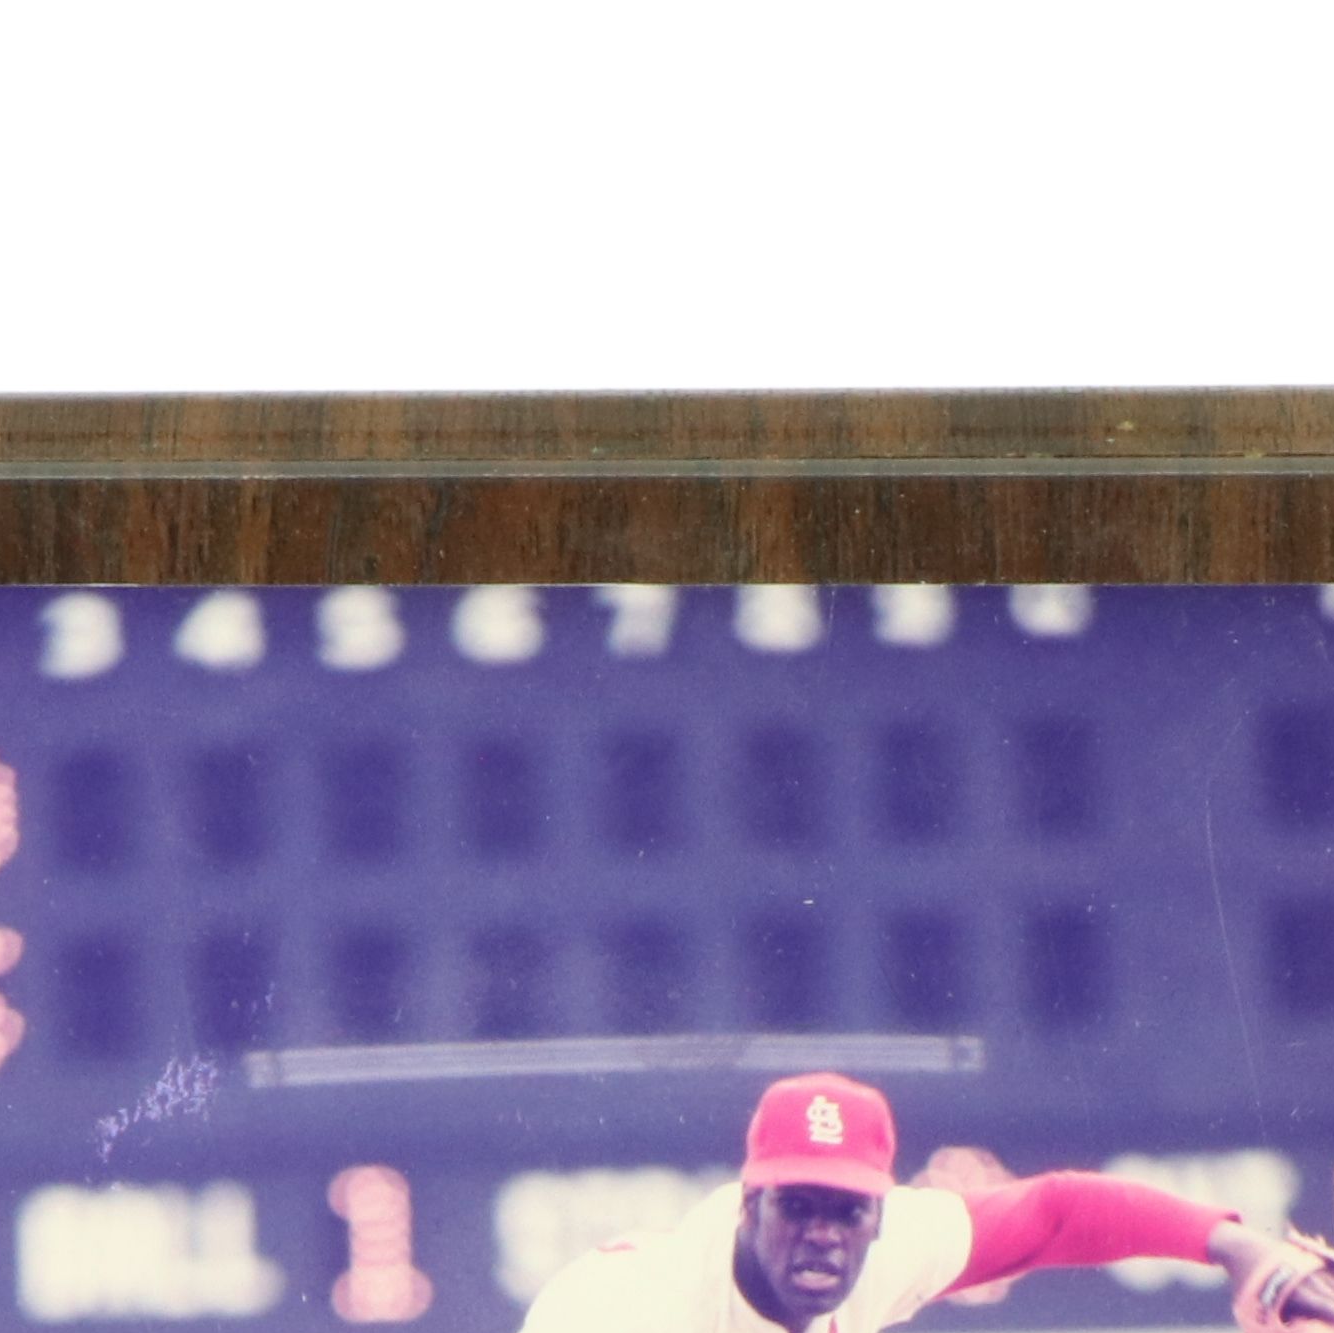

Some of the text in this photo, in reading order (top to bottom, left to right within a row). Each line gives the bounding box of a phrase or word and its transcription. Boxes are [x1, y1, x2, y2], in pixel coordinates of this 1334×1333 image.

[41, 591, 124, 679] 3
[174, 592, 263, 669] 4
[328, 1164, 433, 1324] 1
